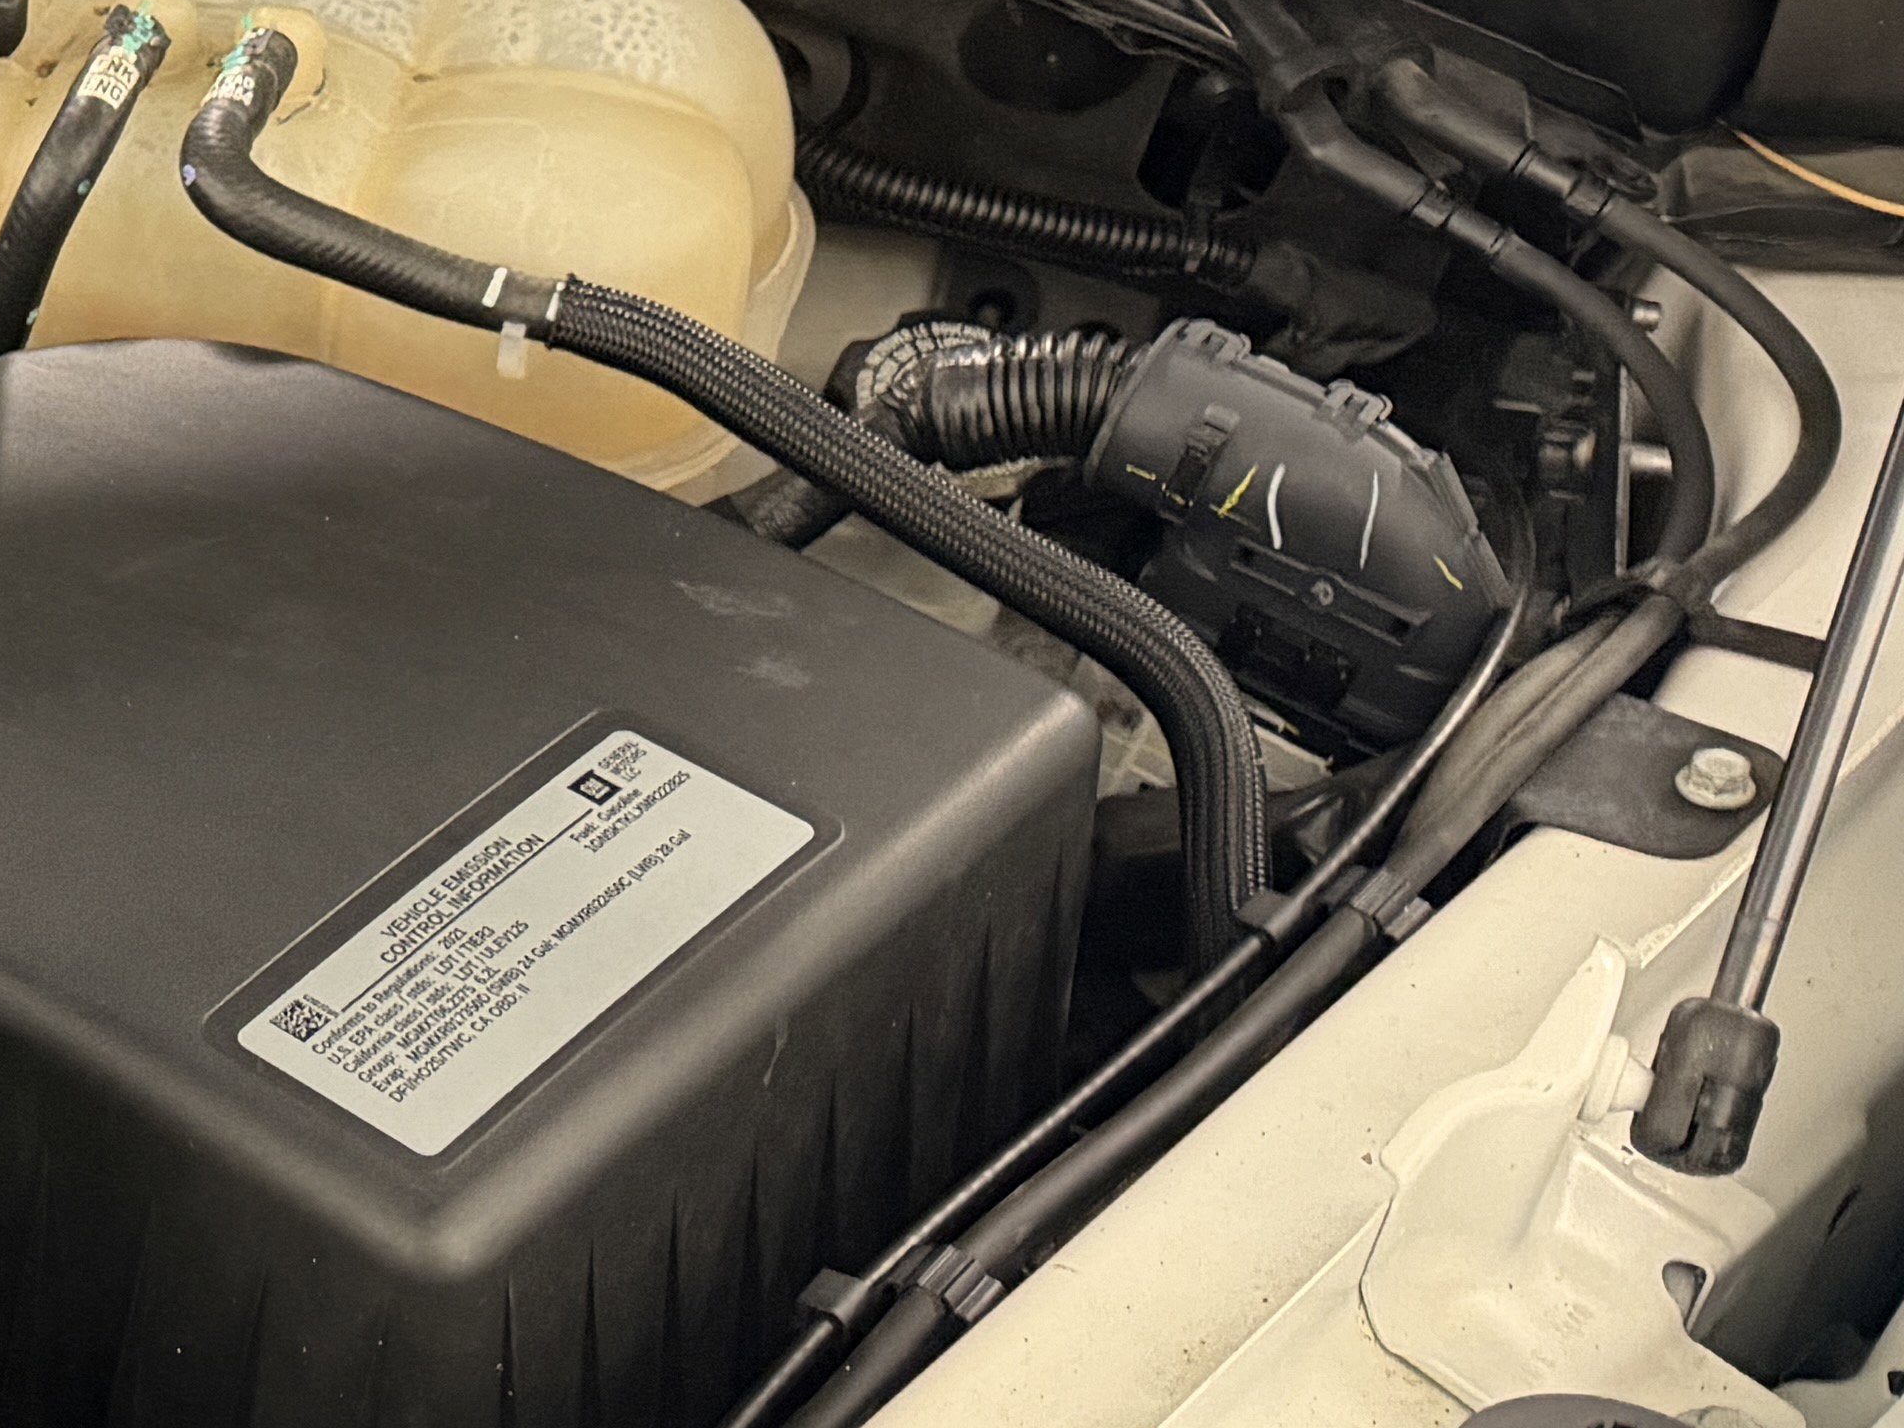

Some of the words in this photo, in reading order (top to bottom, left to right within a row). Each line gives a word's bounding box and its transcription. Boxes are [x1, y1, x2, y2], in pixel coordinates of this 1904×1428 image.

[596, 787, 642, 821] Gasoline
[379, 906, 453, 963] CONTROL
[447, 833, 544, 909] INFORMATION
[380, 888, 447, 939] VEHICLE
[440, 836, 511, 891] EMISSION
[310, 1010, 366, 1053] Conforms
[360, 1000, 378, 1013] to
[372, 949, 443, 1004] Regulations:
[438, 927, 467, 949] 2021
[326, 1042, 353, 1063] U.S.
[348, 1023, 378, 1045] EPA
[372, 1002, 403, 1025] class
[432, 954, 461, 975] LDT
[460, 925, 496, 952] TIER3
[340, 1029, 396, 1072] California
[389, 1007, 422, 1032] class
[452, 960, 481, 981] LDT
[480, 919, 530, 957] ULEV125
[356, 1049, 399, 1082] Group:
[473, 964, 500, 984] 6.2L
[372, 1063, 408, 1091] Evap:
[517, 955, 538, 970] 24
[667, 829, 692, 846] Gal
[468, 1013, 495, 1033] CA
[486, 989, 522, 1017] OBD:
